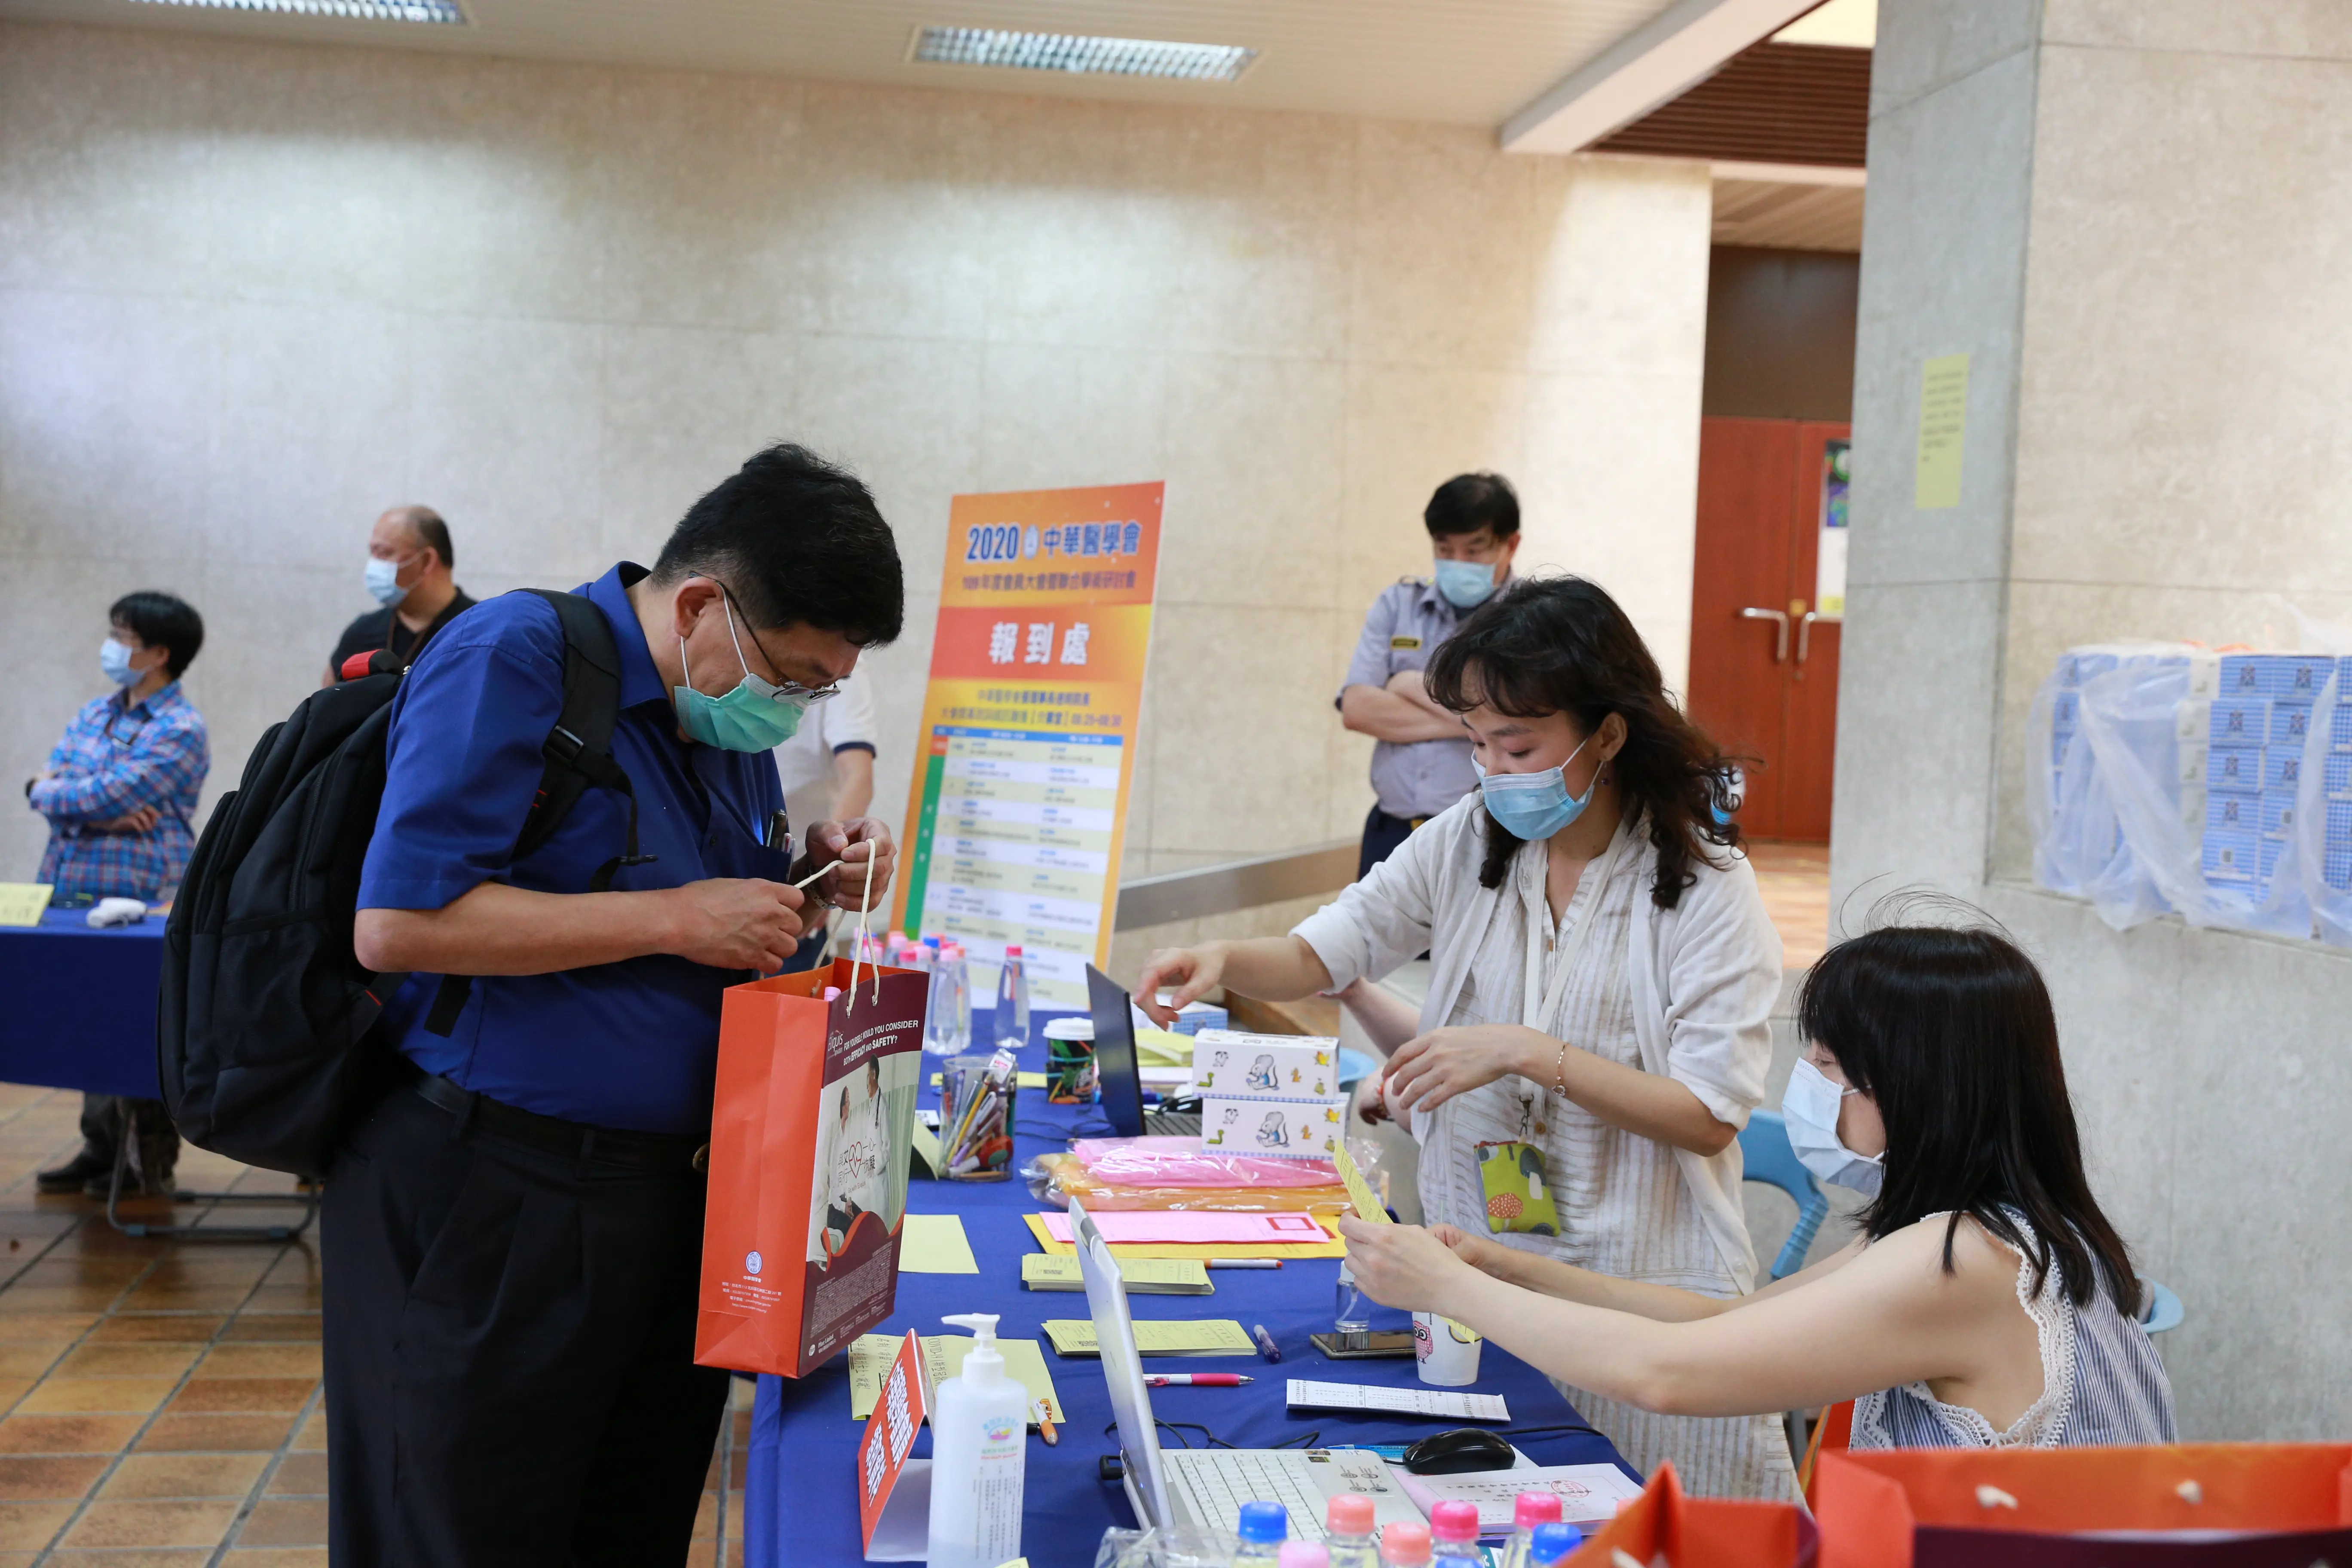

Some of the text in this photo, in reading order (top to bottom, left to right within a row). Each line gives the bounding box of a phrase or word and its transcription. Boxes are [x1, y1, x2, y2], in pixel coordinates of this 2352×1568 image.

[966, 520, 1141, 560] 2020 中華醫學會
[989, 622, 1090, 665] 報到處
[828, 1033, 843, 1052] Eliquis
[850, 1033, 863, 1047] YOURSELF,
[863, 1028, 874, 1040] WOULD
[874, 1025, 885, 1035] YOU
[885, 1020, 919, 1032] CONSIDER
[851, 1042, 866, 1062] EFFICACY
[872, 1035, 898, 1049] SAFETY?
